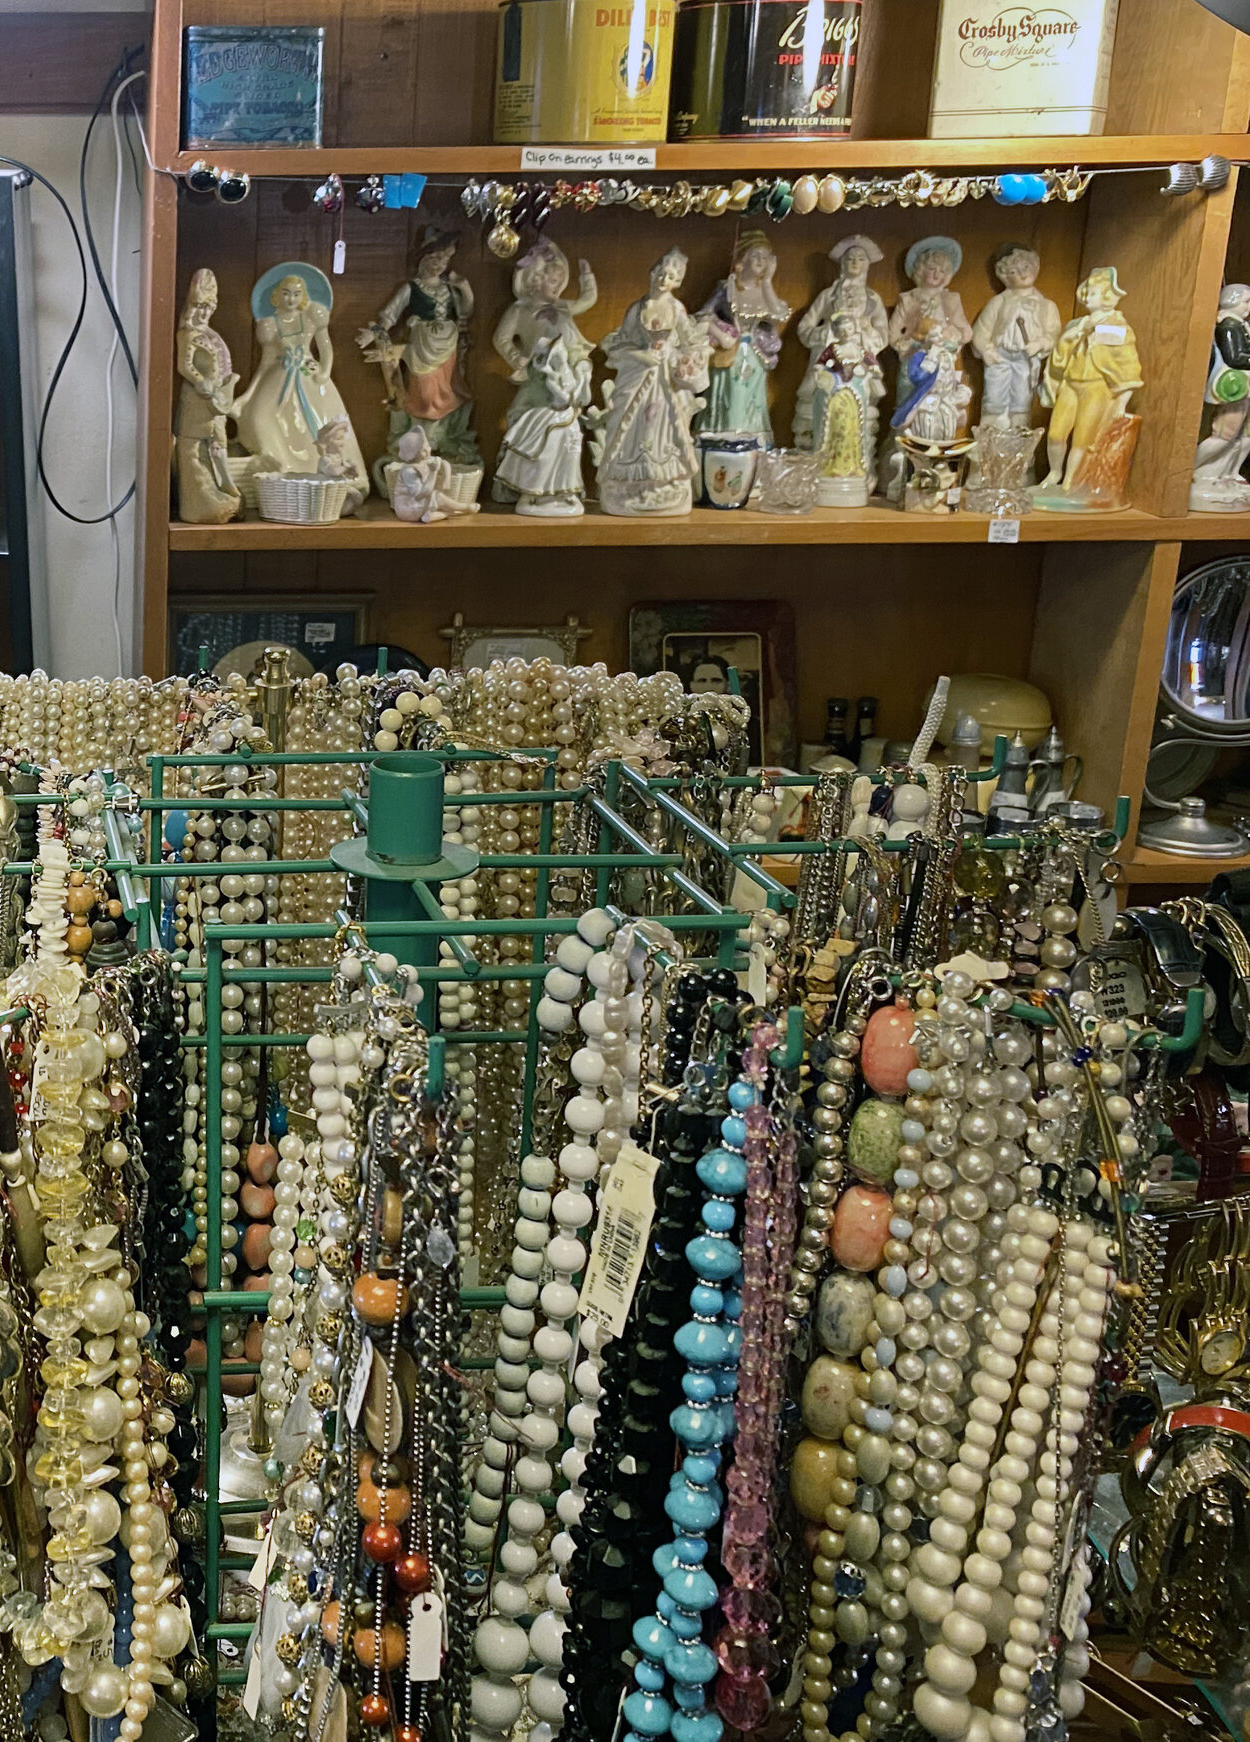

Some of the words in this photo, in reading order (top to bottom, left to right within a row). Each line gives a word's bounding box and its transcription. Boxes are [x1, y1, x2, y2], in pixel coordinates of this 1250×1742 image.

[595, 8, 643, 27] DILL
[958, 17, 1017, 43] Crosby
[1017, 14, 1082, 43] Square
[778, 54, 808, 65] PIP
[778, 117, 786, 126] A
[788, 117, 818, 126] FELLER
[525, 151, 546, 166] Clip
[564, 154, 603, 169] earrings
